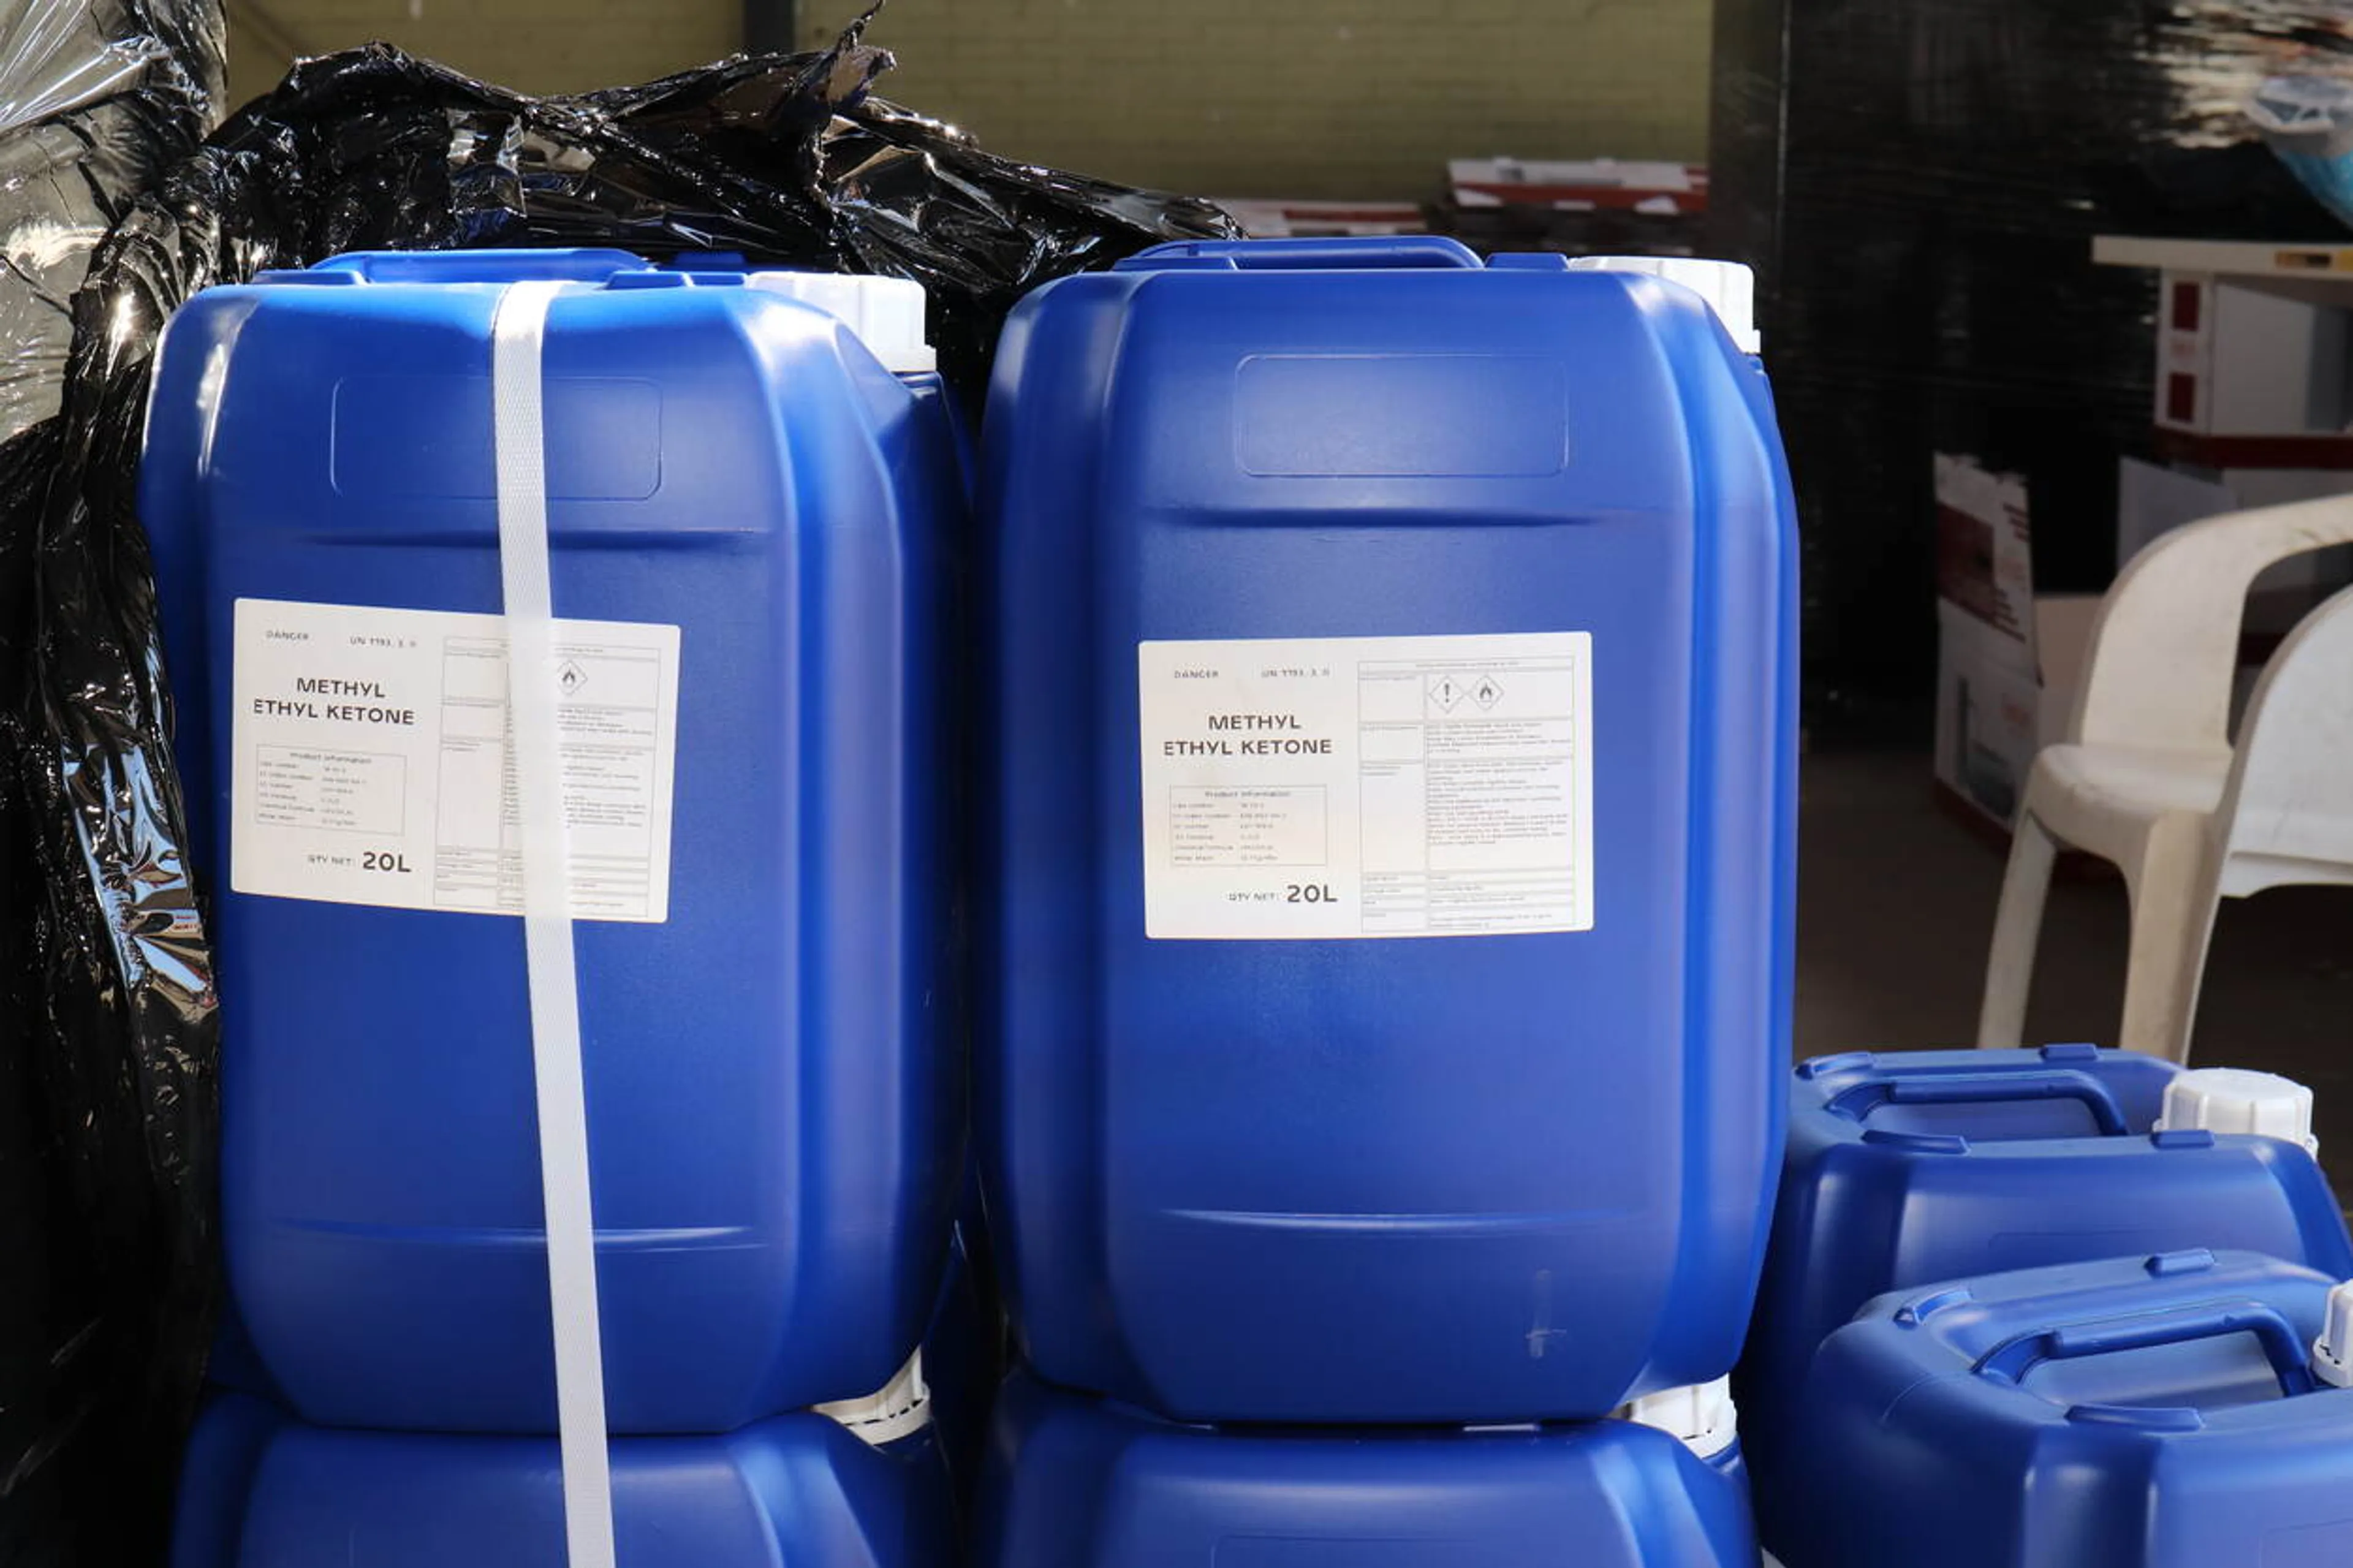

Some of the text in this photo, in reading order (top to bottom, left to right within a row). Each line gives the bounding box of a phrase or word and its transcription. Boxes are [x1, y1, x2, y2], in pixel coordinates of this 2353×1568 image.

[297, 677, 386, 698] METHYL
[254, 699, 415, 725] ETHYL KETONE
[1208, 714, 1302, 730] METHYL
[1163, 739, 1333, 756] ETHYL KETONE
[363, 850, 412, 873] 20L
[1286, 883, 1339, 903] 20L
